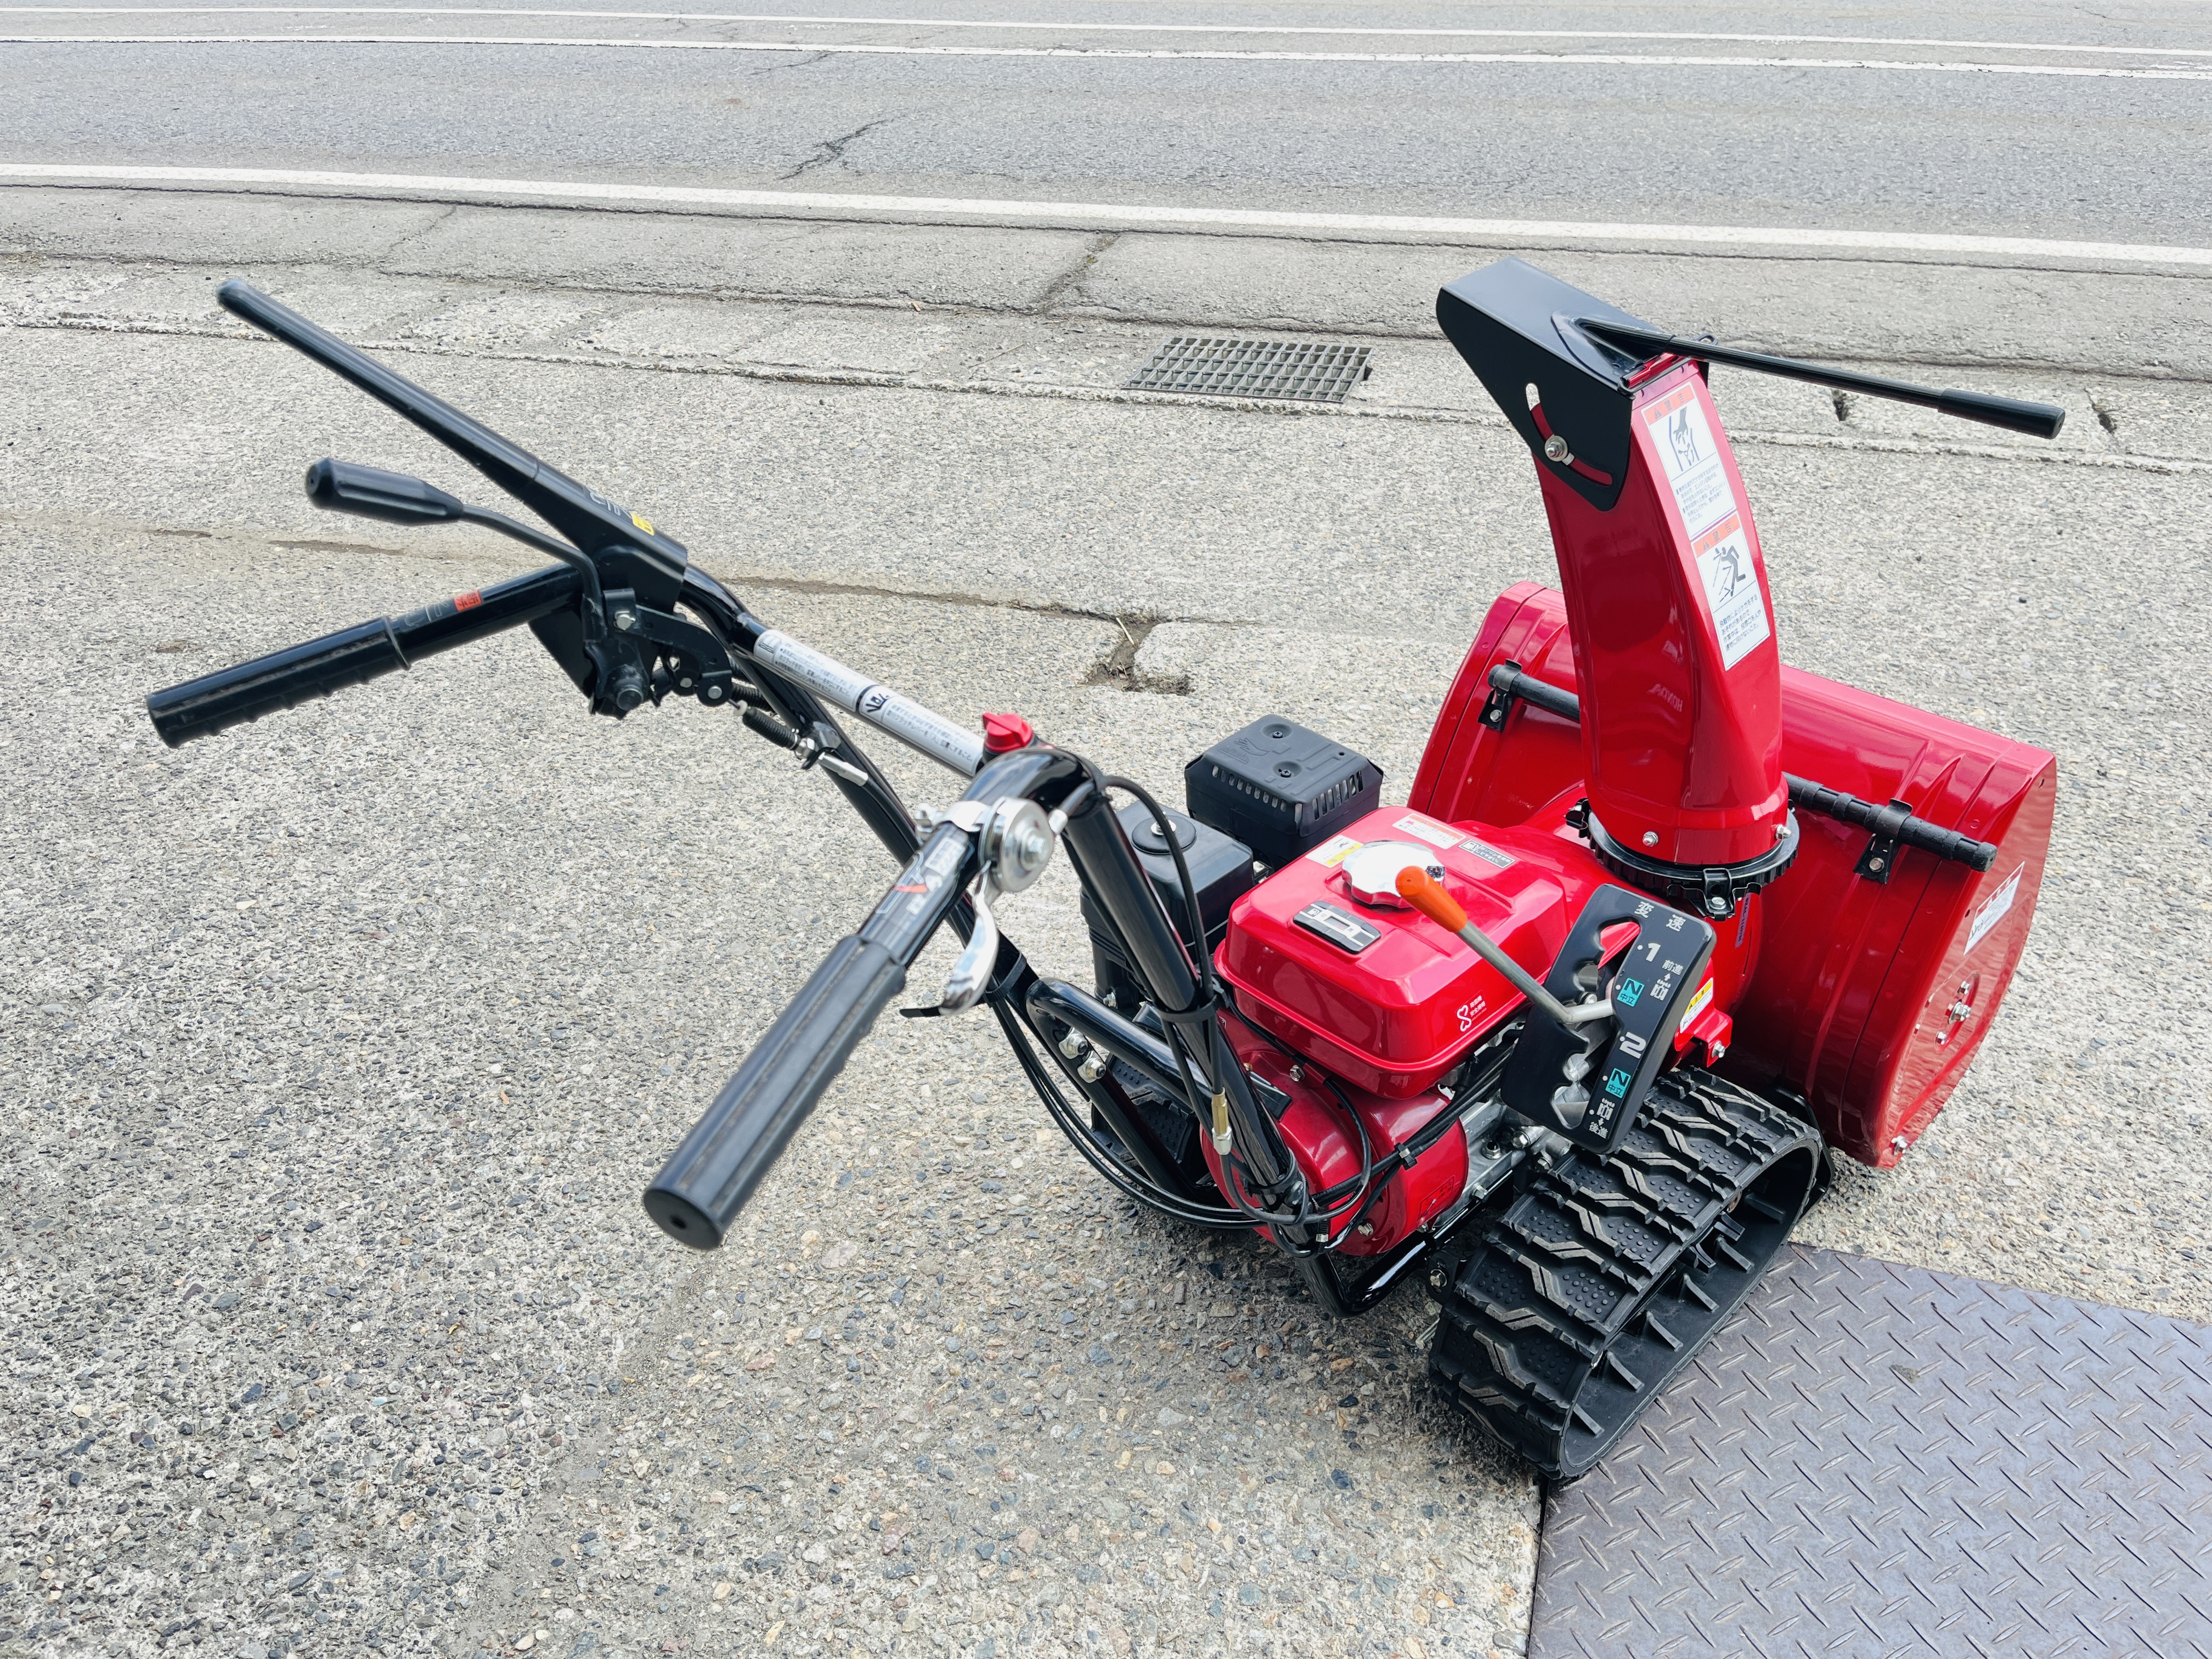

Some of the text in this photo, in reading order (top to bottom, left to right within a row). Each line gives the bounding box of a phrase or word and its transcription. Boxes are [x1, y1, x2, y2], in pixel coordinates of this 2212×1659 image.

[1634, 901, 1686, 932] 変速
[1646, 943, 1661, 962] 1
[1662, 960, 1684, 975] 前進
[1624, 979, 1644, 996] N
[1620, 993, 1635, 1005] 中立
[1620, 1031, 1646, 1059] 2
[1611, 1071, 1630, 1087] N
[1608, 1084, 1623, 1097] 中立
[1589, 1121, 1608, 1139] 後進
